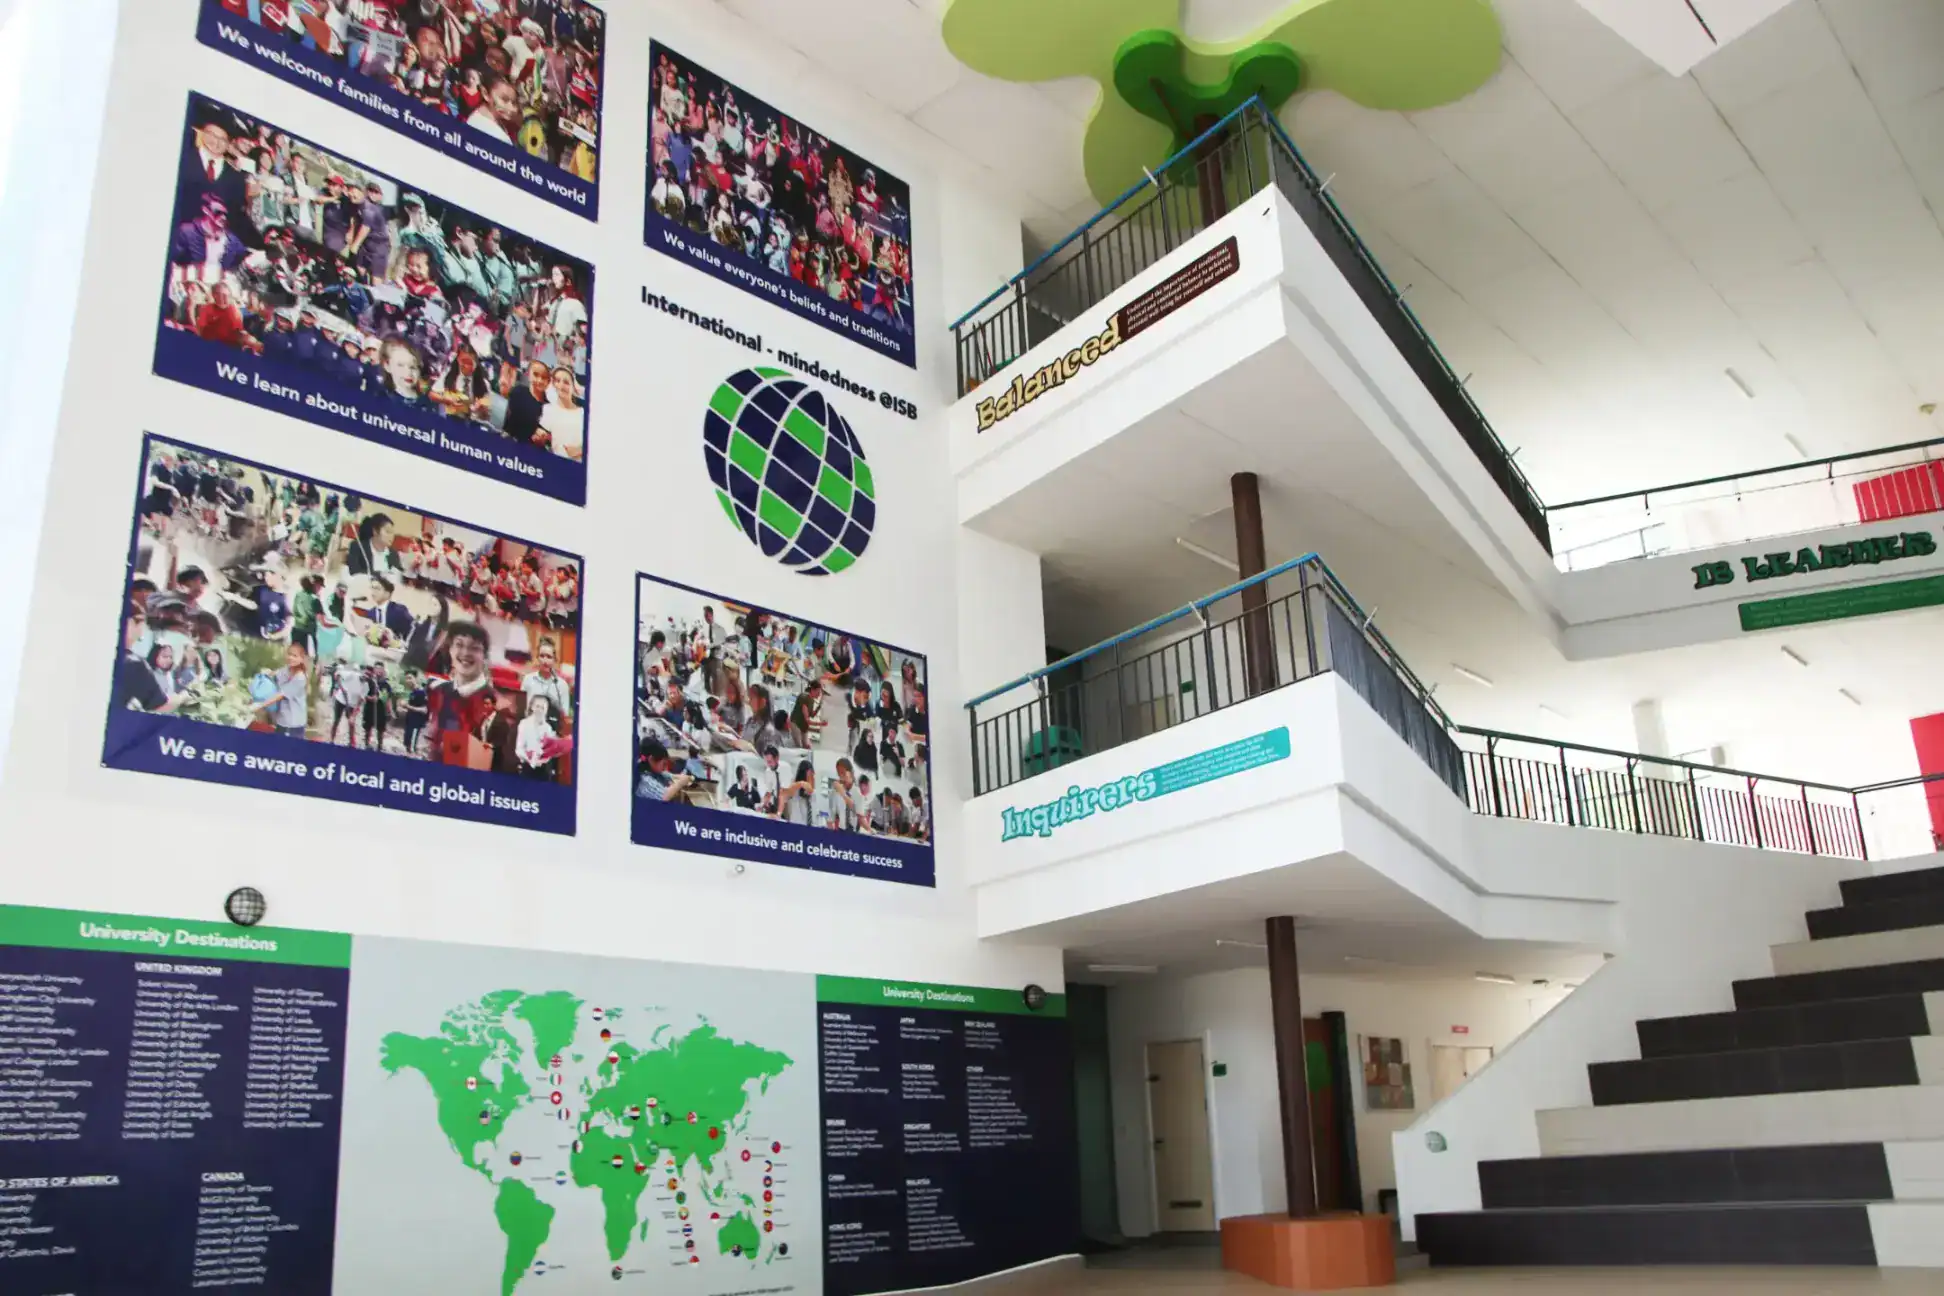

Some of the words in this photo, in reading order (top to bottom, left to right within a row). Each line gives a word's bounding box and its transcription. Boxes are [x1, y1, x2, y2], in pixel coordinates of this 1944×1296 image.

[218, 22, 249, 48] We
[254, 43, 333, 87] welcome
[338, 79, 399, 118] families
[403, 110, 440, 137] from
[444, 132, 461, 147] all
[465, 142, 516, 173] around
[520, 166, 543, 185] the
[547, 180, 585, 205] world
[664, 230, 684, 249] We
[689, 246, 721, 267] value
[725, 263, 786, 297] everyone's
[790, 290, 826, 316] beliefs
[829, 312, 848, 326] and
[852, 321, 900, 351] traditions
[1163, 271, 1191, 292] importance
[1192, 265, 1197, 274] of
[1204, 273, 1214, 282] and
[1147, 301, 1156, 311] and
[642, 286, 761, 352] International
[778, 350, 875, 401] mindedness
[880, 392, 917, 420] @ISB
[976, 314, 1124, 433] Balanced
[217, 362, 247, 384] We
[254, 373, 299, 401] learn
[306, 393, 357, 419] about
[363, 413, 435, 444] universal
[441, 433, 492, 462] human
[497, 456, 543, 478] values
[1692, 560, 1734, 589] IB
[1742, 532, 1937, 582] LEARNER
[160, 736, 196, 759] We
[203, 749, 237, 765] are
[244, 755, 307, 776] aware
[313, 763, 335, 780] of
[340, 765, 384, 789] local
[390, 779, 424, 795] and
[430, 782, 485, 805] global
[490, 791, 539, 813] issues
[1001, 769, 1158, 842] Inquirers
[675, 820, 697, 836] We
[701, 829, 721, 840] are
[726, 829, 777, 849] inclusive
[781, 840, 803, 853] and
[807, 843, 859, 861] celebrate
[863, 854, 902, 868] success
[80, 922, 170, 947] University
[175, 929, 277, 951] Destinations
[134, 962, 172, 972] UNITED
[174, 965, 222, 976] KINGDOM
[883, 987, 924, 1001] University
[926, 989, 974, 1002] Destinations
[9, 1178, 48, 1188] STATES
[50, 1177, 68, 1187] OF
[70, 1176, 120, 1186] AMERICA
[202, 1172, 244, 1181] CANADA
